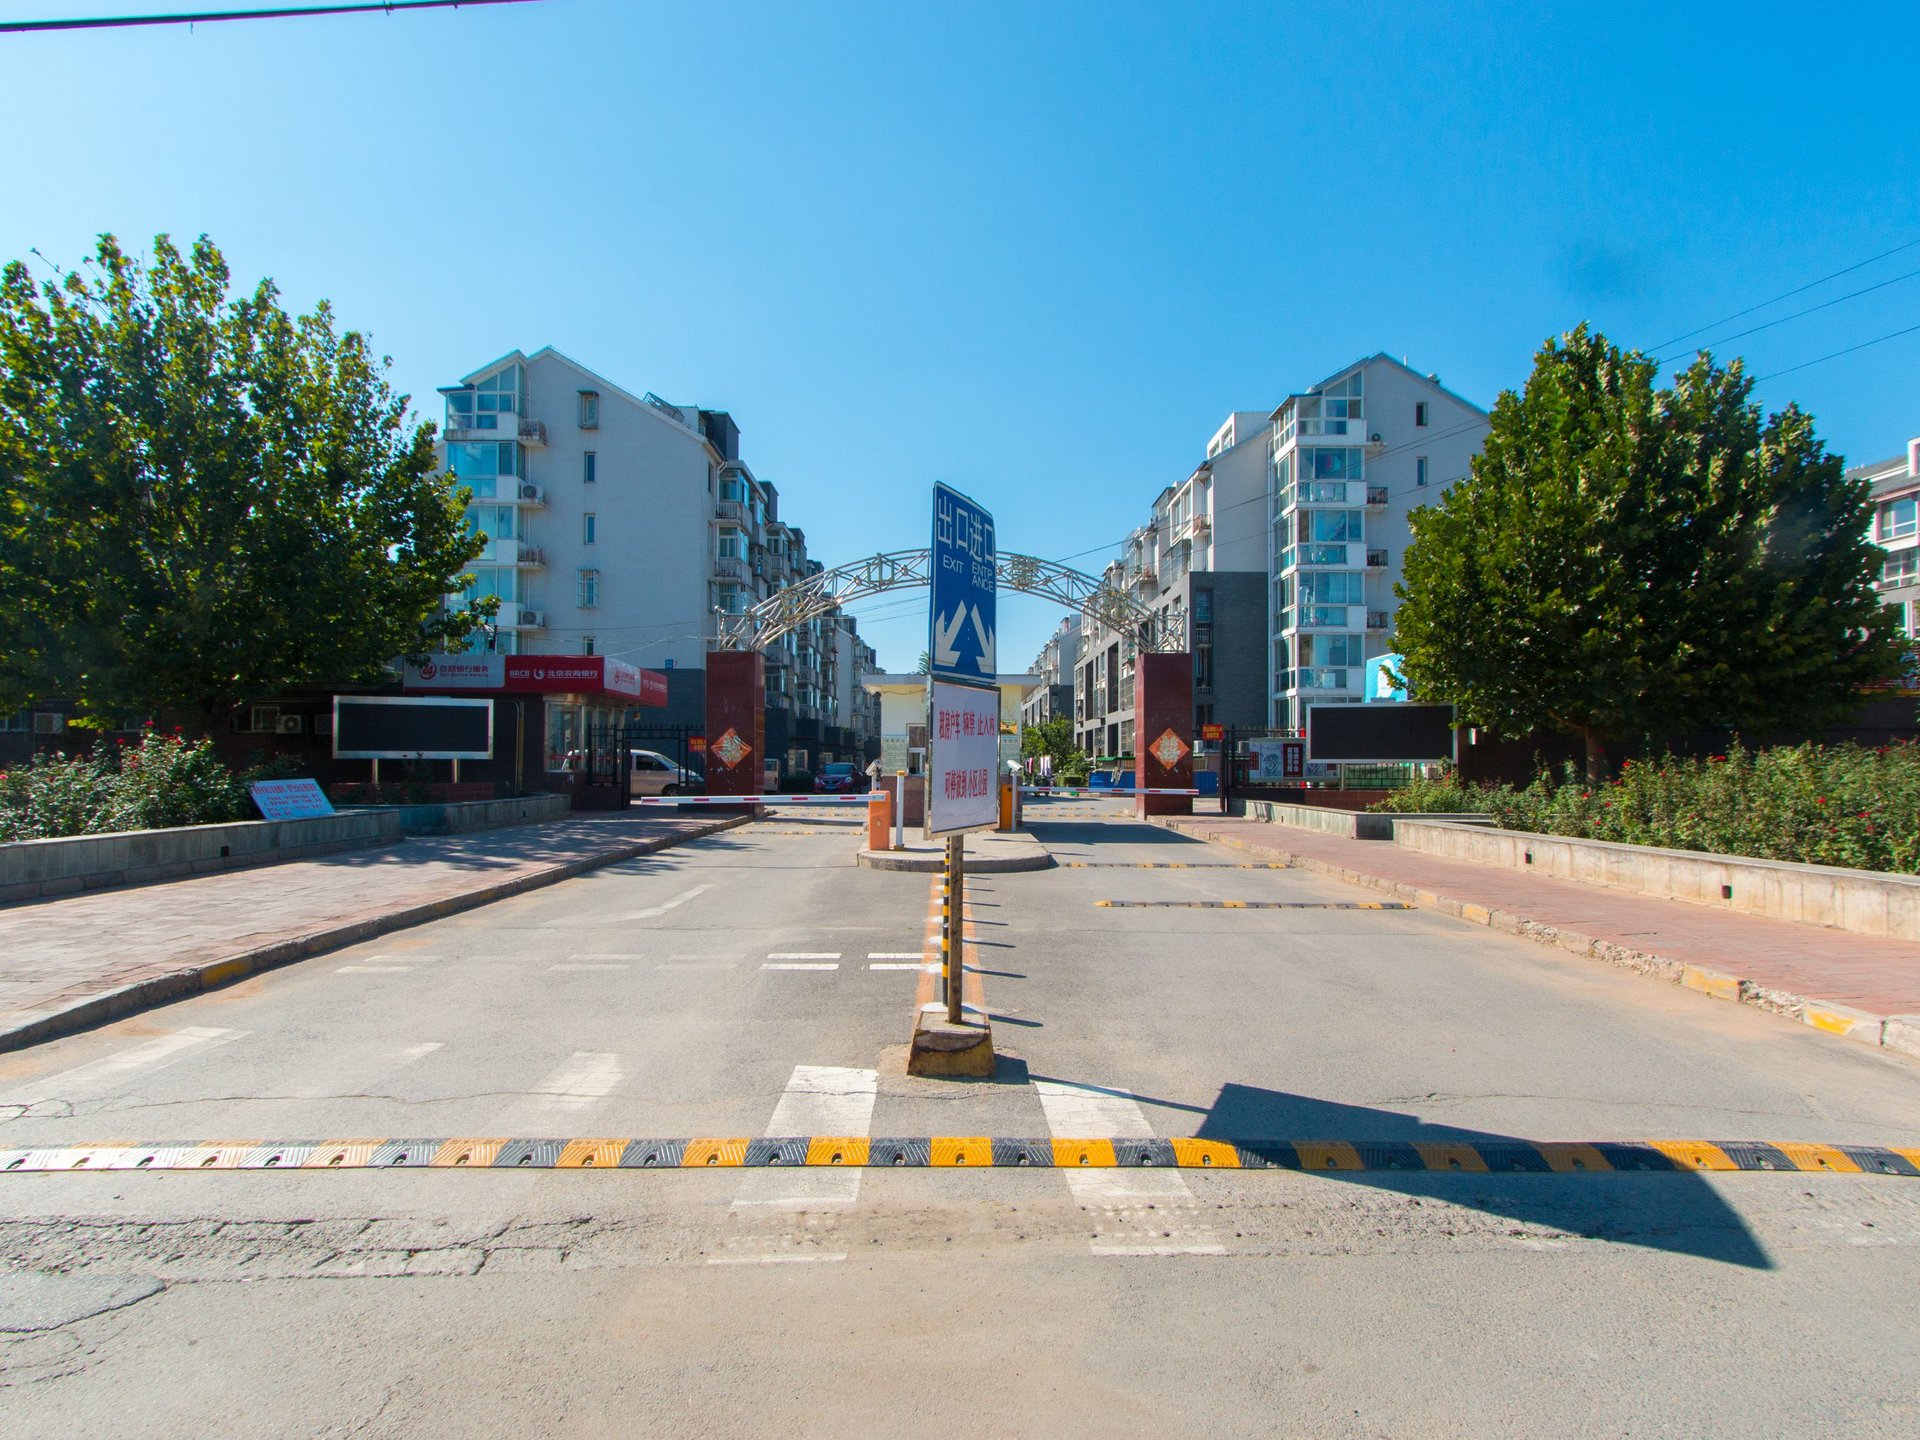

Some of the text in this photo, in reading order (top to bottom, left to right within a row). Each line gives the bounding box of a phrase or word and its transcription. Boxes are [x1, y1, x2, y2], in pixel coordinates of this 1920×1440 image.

[943, 555, 964, 573] EXIT
[972, 574, 994, 593] ANCE
[547, 670, 598, 678] 北京农商银行
